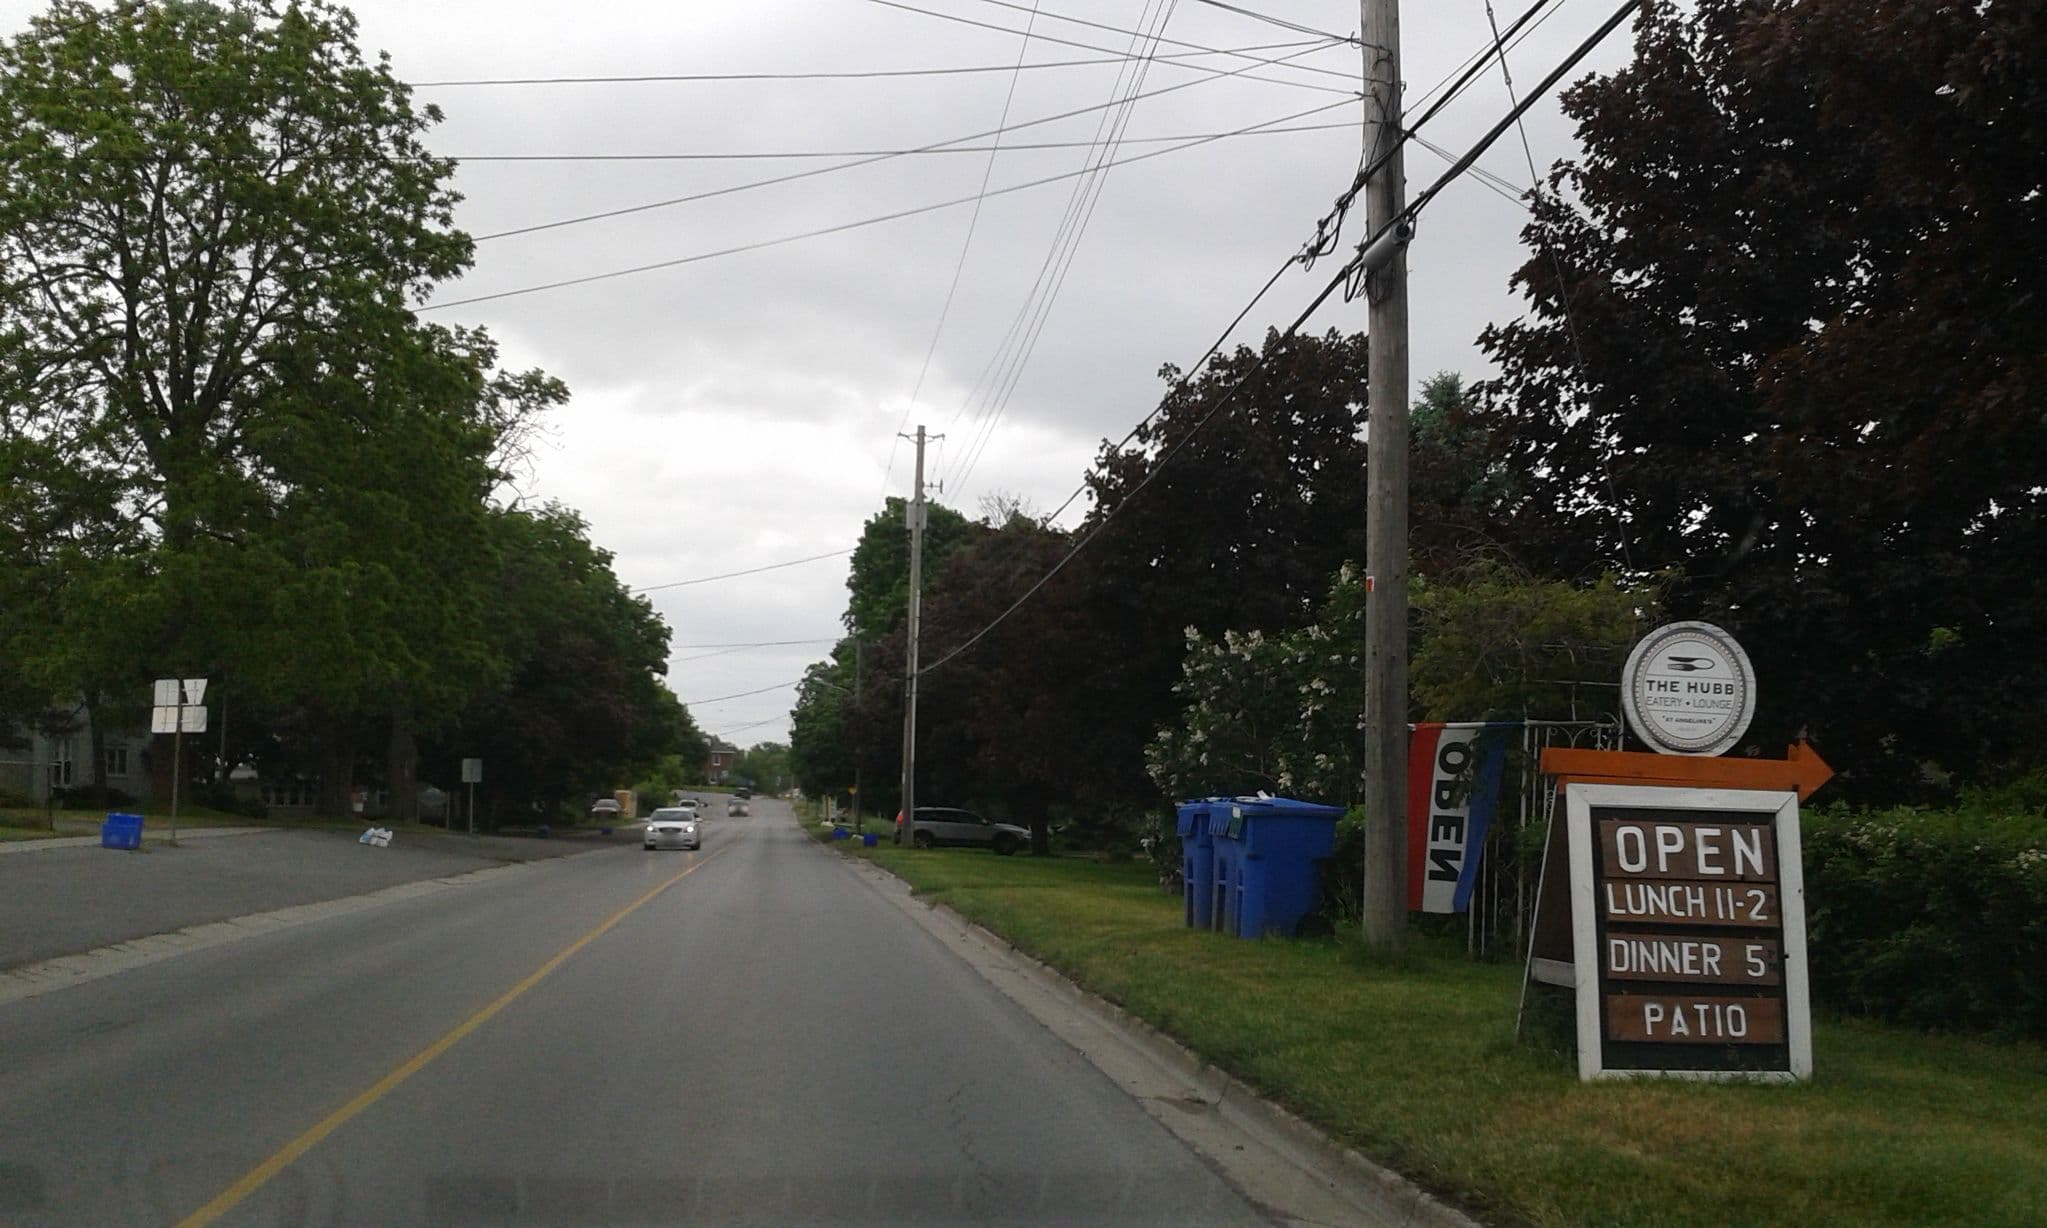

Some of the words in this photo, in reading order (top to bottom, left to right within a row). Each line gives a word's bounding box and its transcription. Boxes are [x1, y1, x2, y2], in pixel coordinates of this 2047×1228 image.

[1646, 680, 1680, 692] THE
[1687, 682, 1734, 695] HUBB
[1646, 696, 1681, 707] EATERY
[1693, 699, 1733, 709] LOUNGE
[1616, 826, 1764, 875] OPEN
[1607, 883, 1706, 918] LUNCH
[1716, 887, 1768, 920] 11-2
[1610, 939, 1721, 976] DINNER
[1746, 945, 1766, 977] 5
[1644, 1003, 1747, 1037] PATIO
